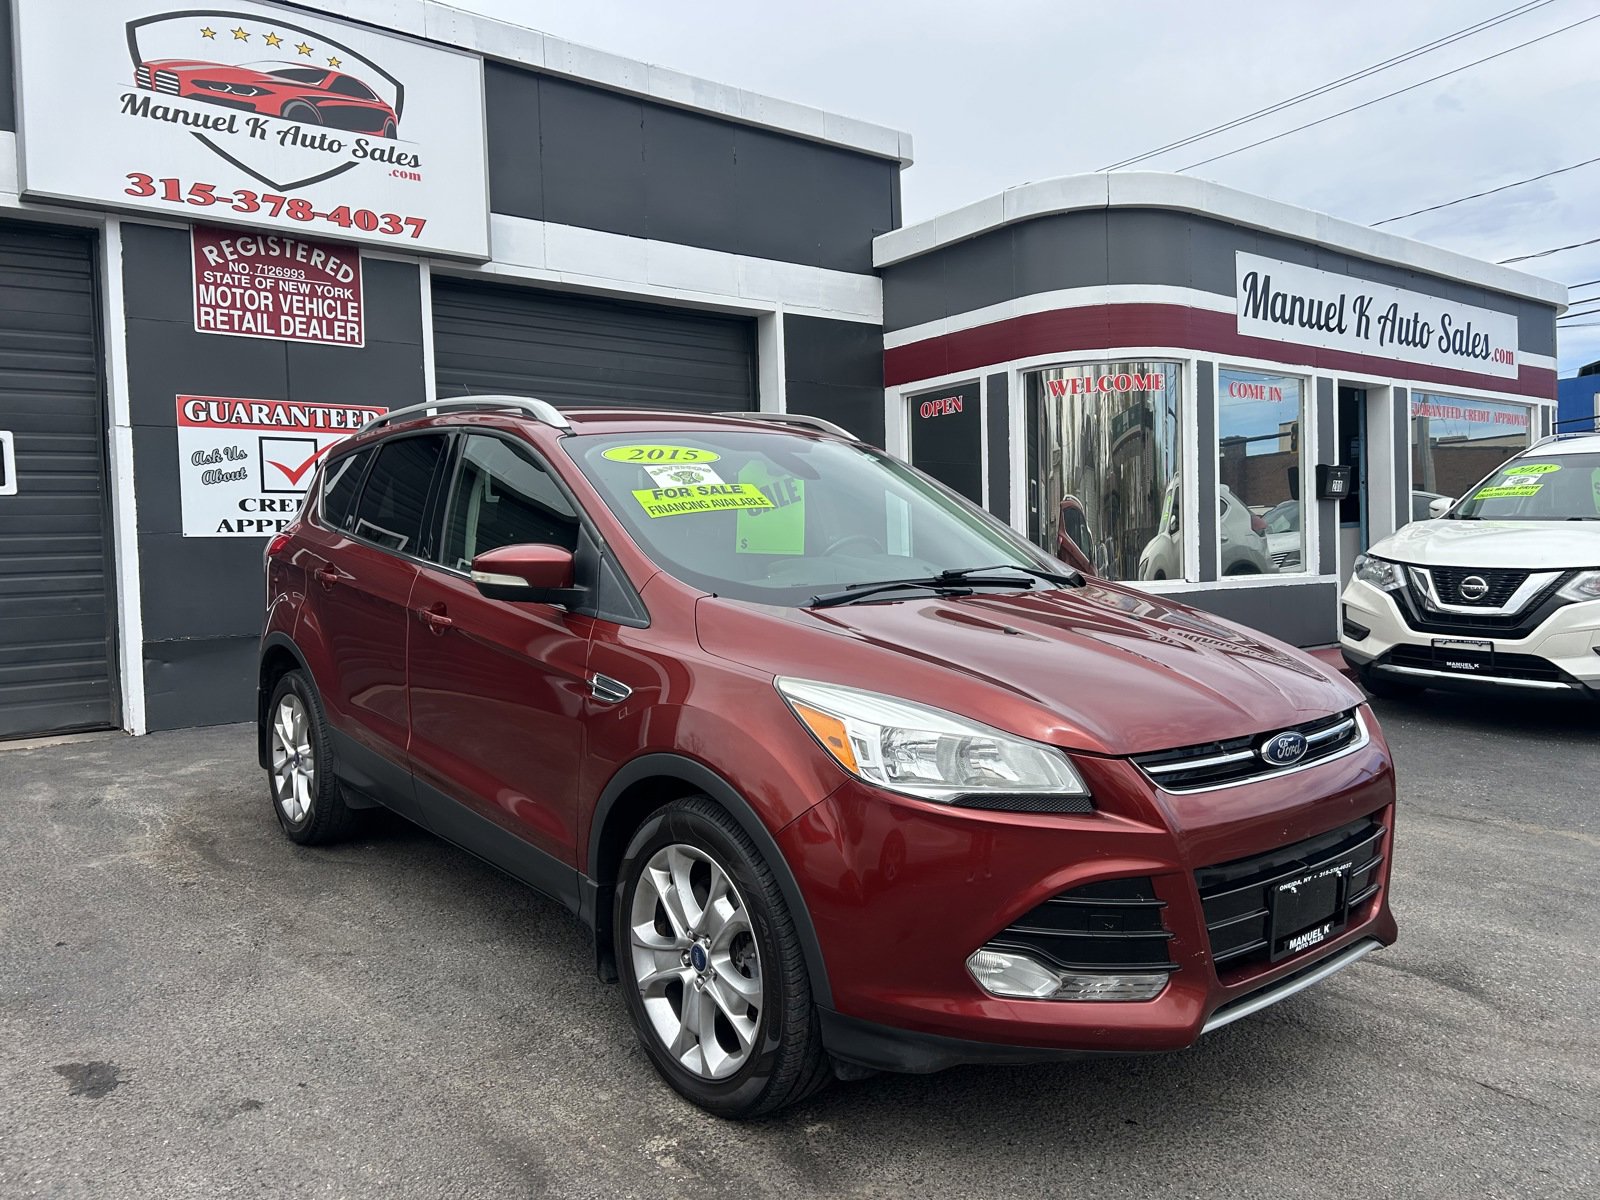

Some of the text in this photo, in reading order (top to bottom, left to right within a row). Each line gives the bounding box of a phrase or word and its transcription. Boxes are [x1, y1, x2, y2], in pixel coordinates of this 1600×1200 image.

[119, 93, 422, 168] Manuel K Auto Sales
[388, 169, 421, 182] .com
[124, 172, 427, 238] 315-378-4037
[202, 235, 354, 284] REGISTERED
[228, 262, 306, 280] NO. 7126993
[204, 271, 353, 300] STATE OF NEW YORK
[199, 284, 359, 322] MOTOR VEHICLE
[1242, 271, 1347, 334] Manuel
[1352, 295, 1373, 340] K
[1377, 302, 1434, 349] Auto
[200, 307, 360, 342] RETAIL DEALER
[1047, 372, 1166, 398] WELCOME
[1229, 381, 1282, 402] COME IN
[183, 399, 381, 429] GUARANTEED
[920, 395, 963, 419] OPEN
[191, 446, 247, 466] Ask Us
[628, 448, 699, 461] 2015
[202, 467, 247, 485] About
[652, 484, 744, 500] FOR SALE
[648, 497, 769, 515] FINANCING AVAILABLE
[1277, 737, 1301, 758] Ford
[1289, 923, 1330, 949] MANUEL K
[1295, 941, 1308, 952] AUTO
